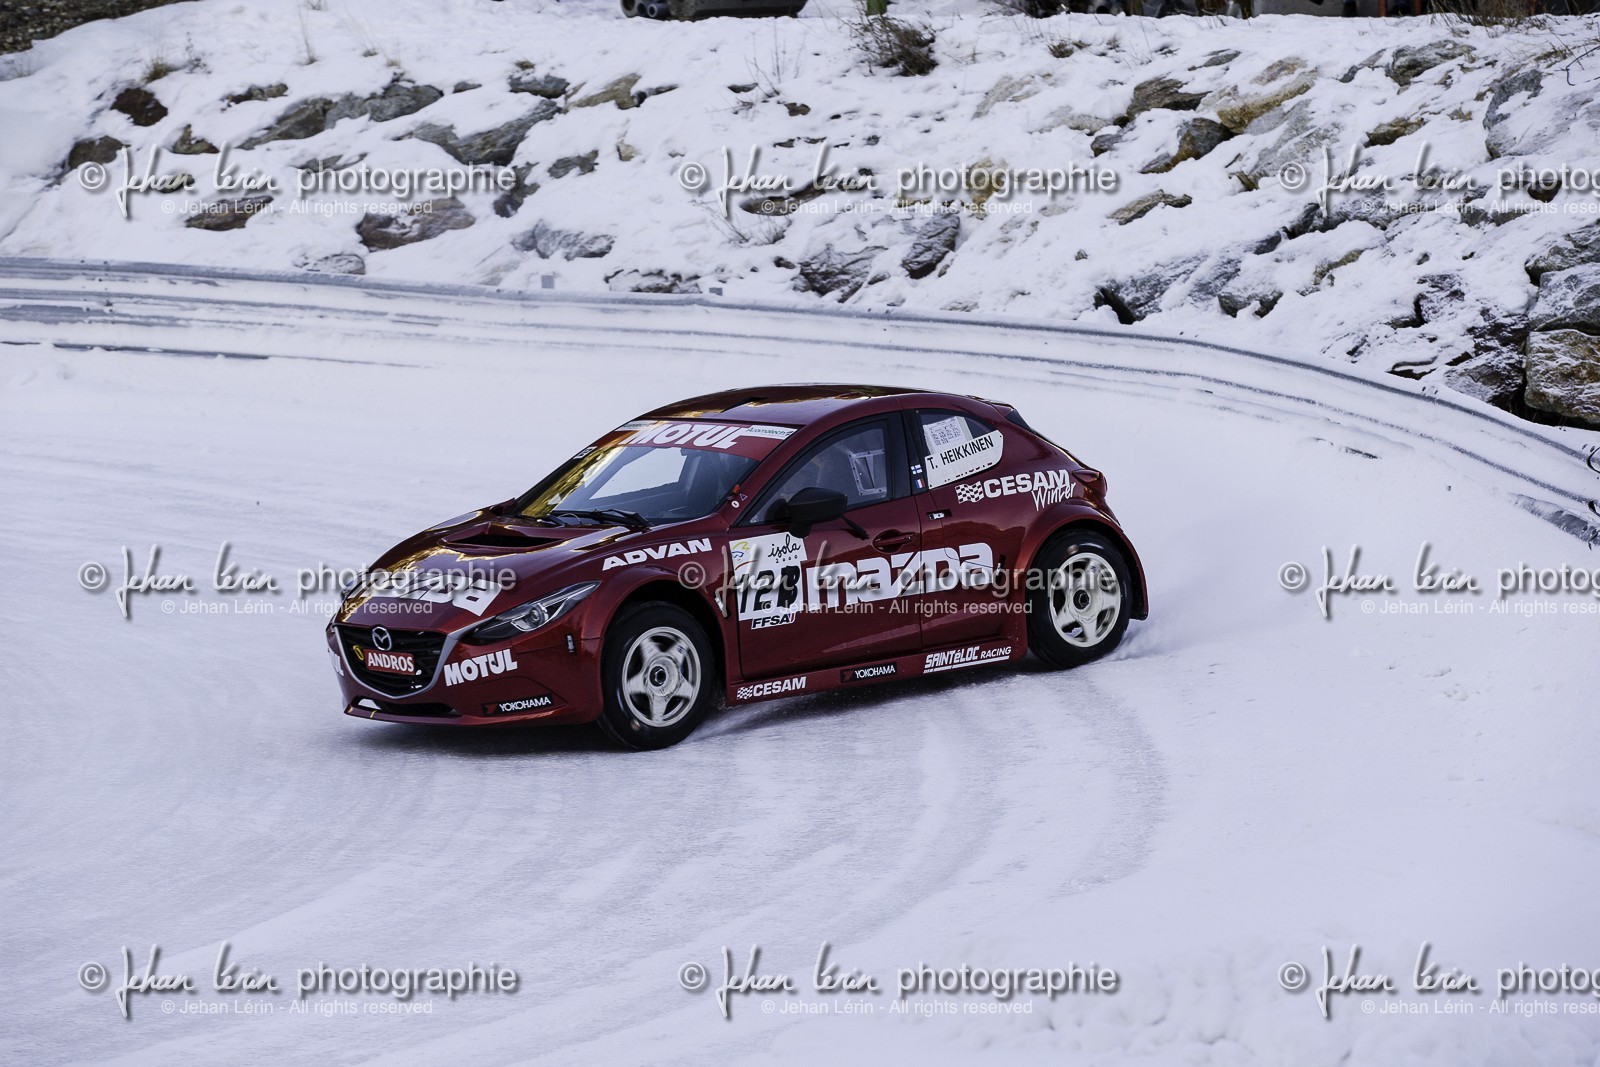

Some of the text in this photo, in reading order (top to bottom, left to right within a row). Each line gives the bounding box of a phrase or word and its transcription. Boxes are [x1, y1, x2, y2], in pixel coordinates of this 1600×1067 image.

[618, 423, 738, 449] MOTUL
[927, 435, 994, 469] T. HEIKKINEN
[983, 469, 1070, 498] CESAM
[1031, 482, 1077, 511] Winter
[602, 538, 712, 571] ADVAN
[767, 534, 801, 558] isola
[806, 542, 994, 612] mazda
[752, 614, 790, 628] FFSA
[368, 652, 415, 673] ANDROS
[980, 646, 1012, 660] RACING
[443, 648, 518, 687] MOTUL
[854, 664, 896, 679] YOKOHAMA
[752, 676, 807, 697] CESAM
[499, 696, 552, 712] YOKOHAMA
